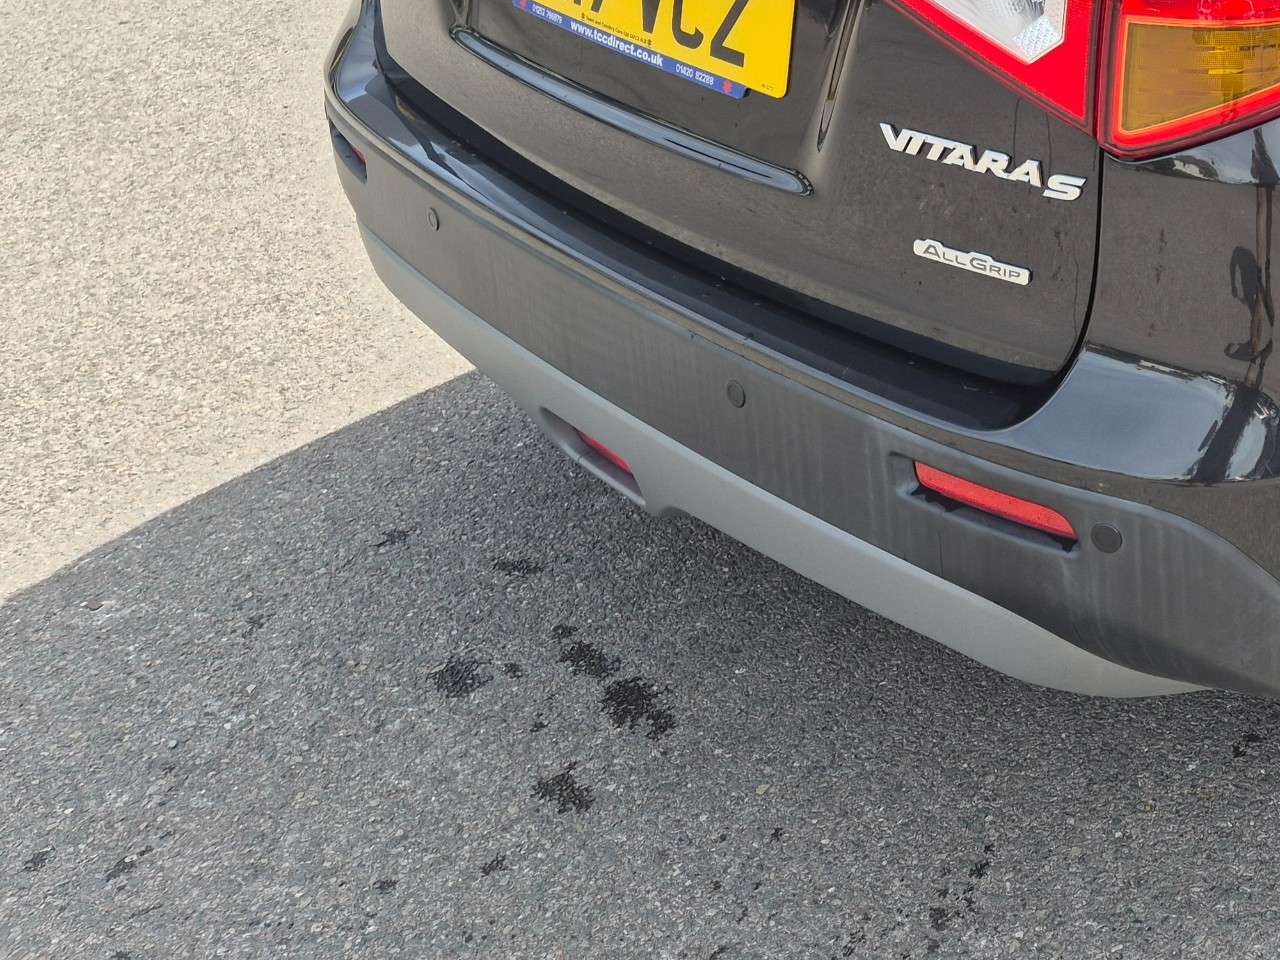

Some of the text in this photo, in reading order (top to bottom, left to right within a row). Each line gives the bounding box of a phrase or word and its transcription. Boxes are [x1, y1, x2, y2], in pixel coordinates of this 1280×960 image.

[570, 20, 664, 68] www.tccdirect.co.uk
[880, 122, 1088, 201] VITARA S
